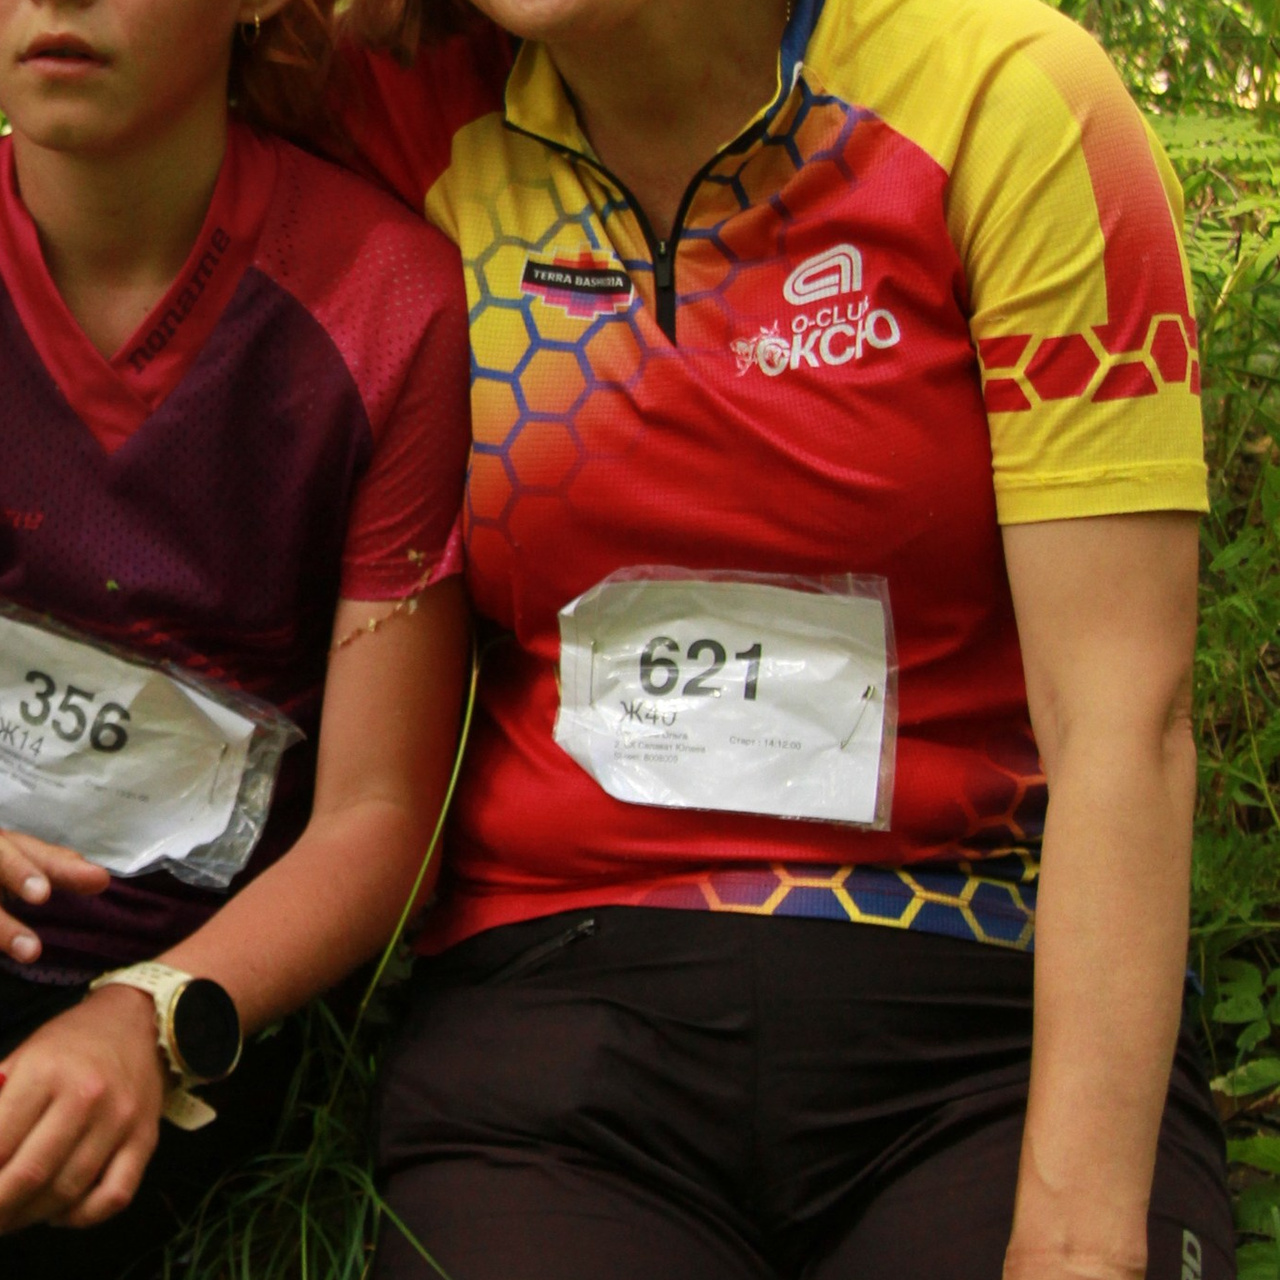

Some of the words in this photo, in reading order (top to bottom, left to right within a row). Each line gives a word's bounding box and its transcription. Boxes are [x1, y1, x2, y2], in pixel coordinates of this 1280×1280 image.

[127, 227, 231, 374] noname
[533, 269, 572, 284] TERRA
[639, 636, 763, 701] 621
[19, 670, 132, 753] 356
